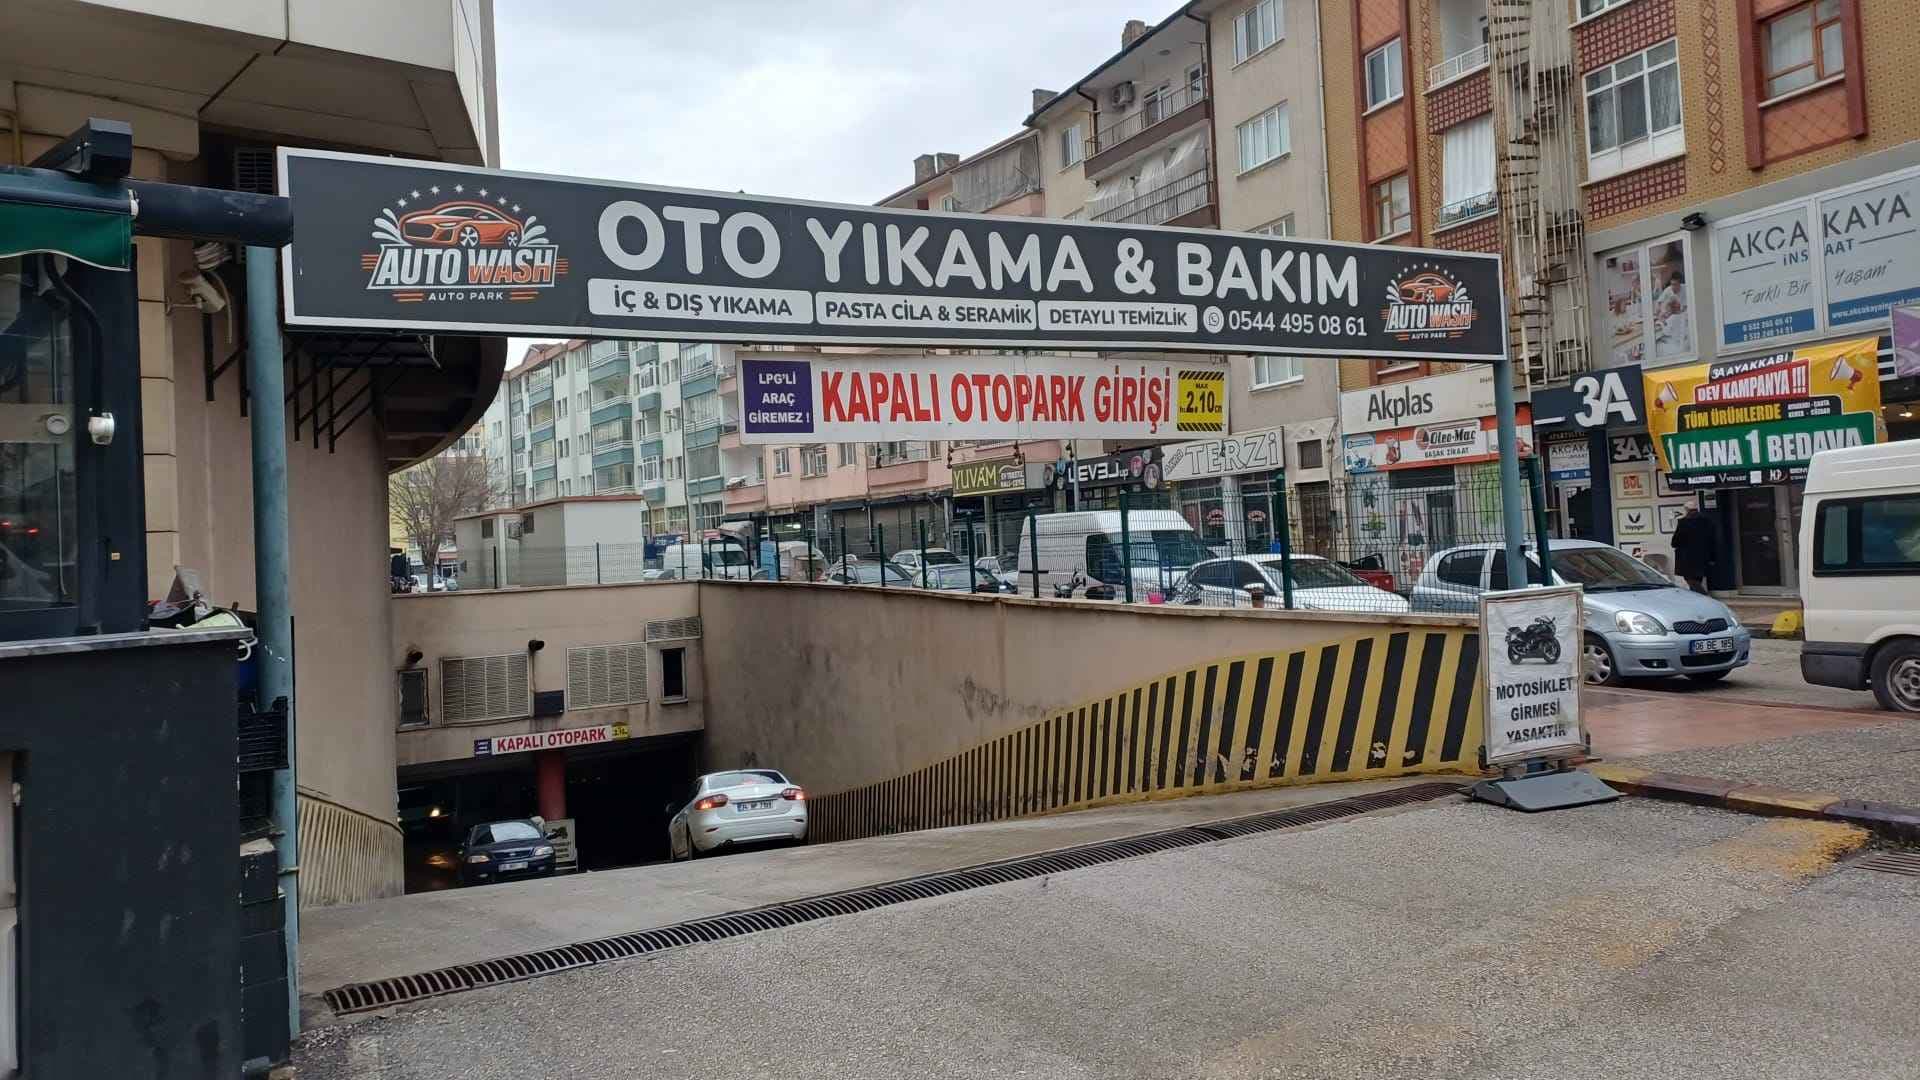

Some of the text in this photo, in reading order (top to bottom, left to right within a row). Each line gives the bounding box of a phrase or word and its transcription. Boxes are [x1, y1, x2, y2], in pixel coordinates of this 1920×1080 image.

[1823, 194, 1912, 240] KAYA
[375, 247, 554, 286] AUTO WASH
[599, 200, 1359, 307] OTO YIKAMA & BAKIM
[428, 291, 504, 301] AUTO PARK
[614, 289, 793, 316] İÇ & DIŞ YIKAMA
[825, 296, 1032, 326] PASTA CİLA & SERAMİK
[1048, 304, 1188, 329] DETAYLI TEMİZLİK
[1228, 310, 1367, 336] 0544 495 08 61
[1388, 303, 1470, 330] AUTO WASH
[1696, 384, 1721, 402] DEV
[1722, 368, 1791, 400] KAMPANYA
[761, 393, 796, 407] ARAÇ
[820, 364, 1171, 435] KAPALI OTOPARK GİRİŞİ
[1368, 386, 1434, 427] Akplas
[1573, 371, 1637, 428] 3A
[749, 410, 805, 424] GİREMEZ
[1684, 402, 1782, 431] TÜM ÜRÜNLERDE
[1613, 437, 1642, 461] 3A
[1678, 438, 1743, 470] ALANA
[1744, 429, 1761, 465] 1
[953, 464, 997, 491] YUVAM
[1496, 676, 1574, 701] MOTOSİKLET
[1510, 698, 1561, 722] GİRMESİ
[497, 735, 544, 753] KAPALI
[547, 727, 607, 746] OTOPARK
[1506, 723, 1567, 744] YASAKTIR
